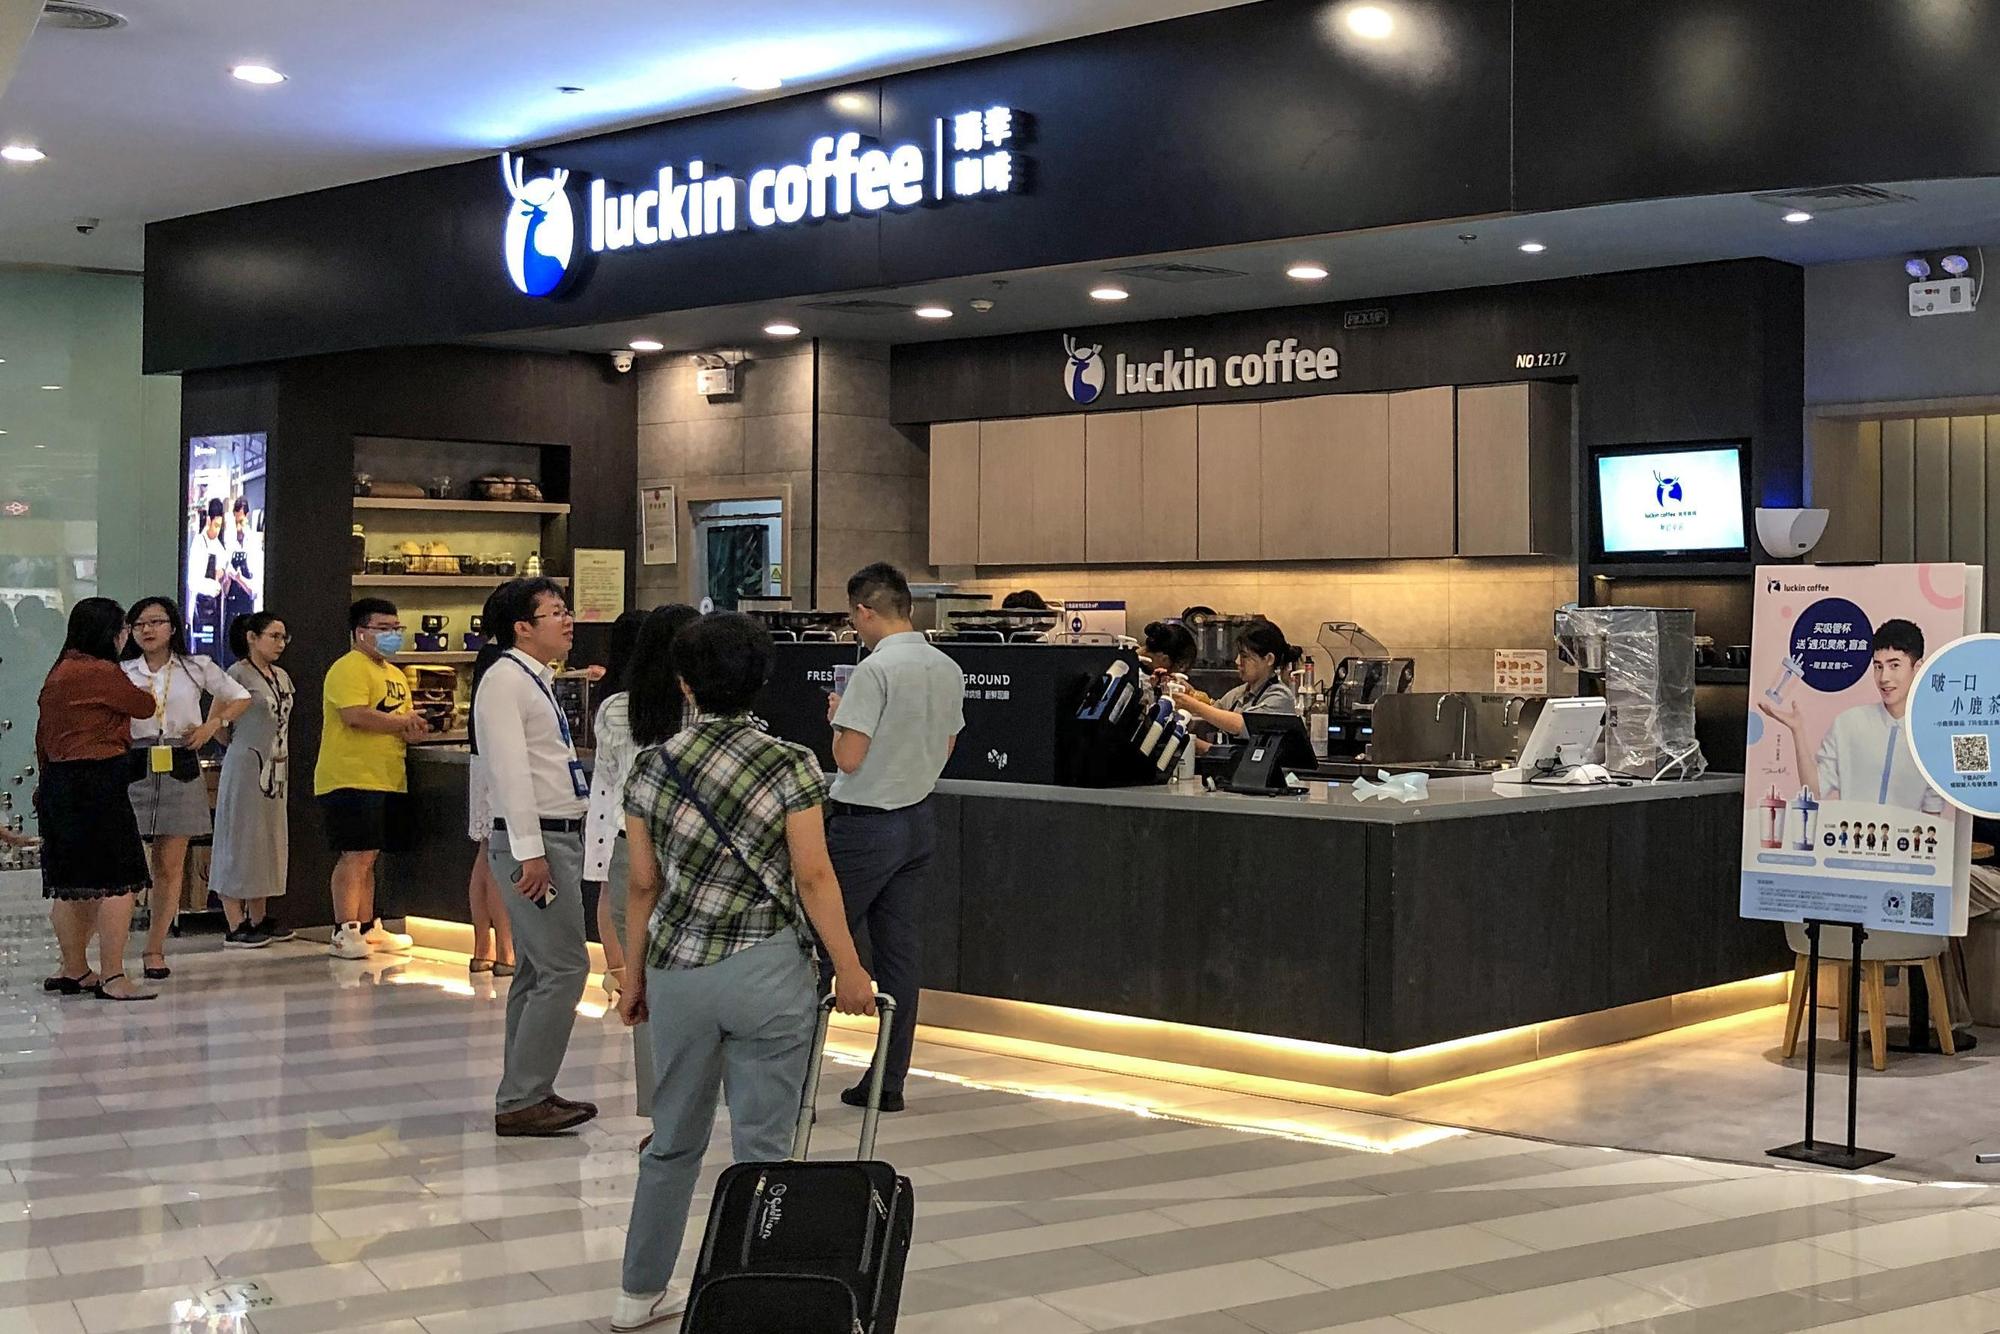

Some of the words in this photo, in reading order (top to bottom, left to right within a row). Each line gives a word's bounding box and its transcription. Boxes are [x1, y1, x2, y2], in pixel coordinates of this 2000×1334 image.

[591, 160, 736, 252] luckin
[749, 131, 924, 227] coffee
[1115, 348, 1217, 395] luckin
[1226, 338, 1339, 386] coffee
[1515, 351, 1567, 369] NO.1217
[1783, 584, 1806, 592] luckin
[1806, 584, 1830, 592] coffee
[1813, 622, 1853, 634] 买吸管杯
[807, 670, 836, 682] FRES
[962, 673, 1011, 685] GROUND
[1931, 673, 1977, 693] 啵一口
